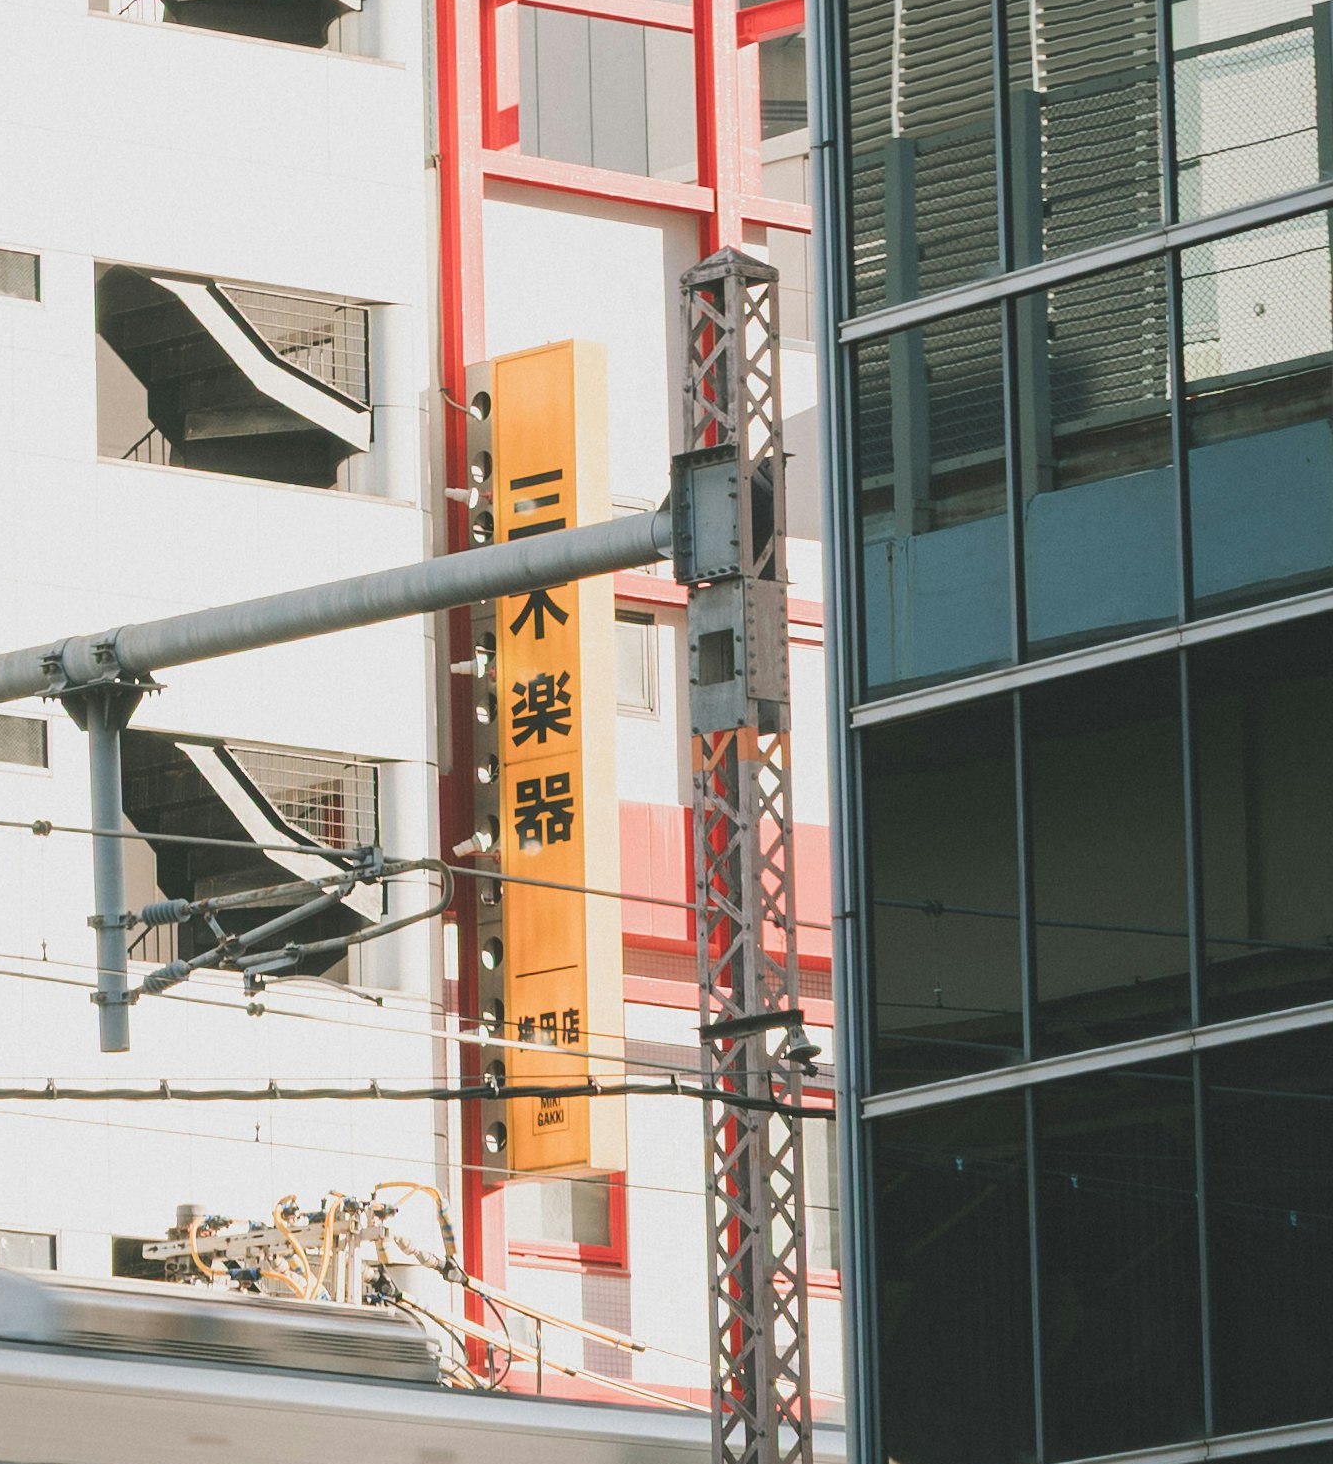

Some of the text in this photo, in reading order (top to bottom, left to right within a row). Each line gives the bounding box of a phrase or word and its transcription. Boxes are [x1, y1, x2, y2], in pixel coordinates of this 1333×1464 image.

[508, 469, 575, 851] 三木楽器
[537, 1109, 565, 1127] GAKKI
